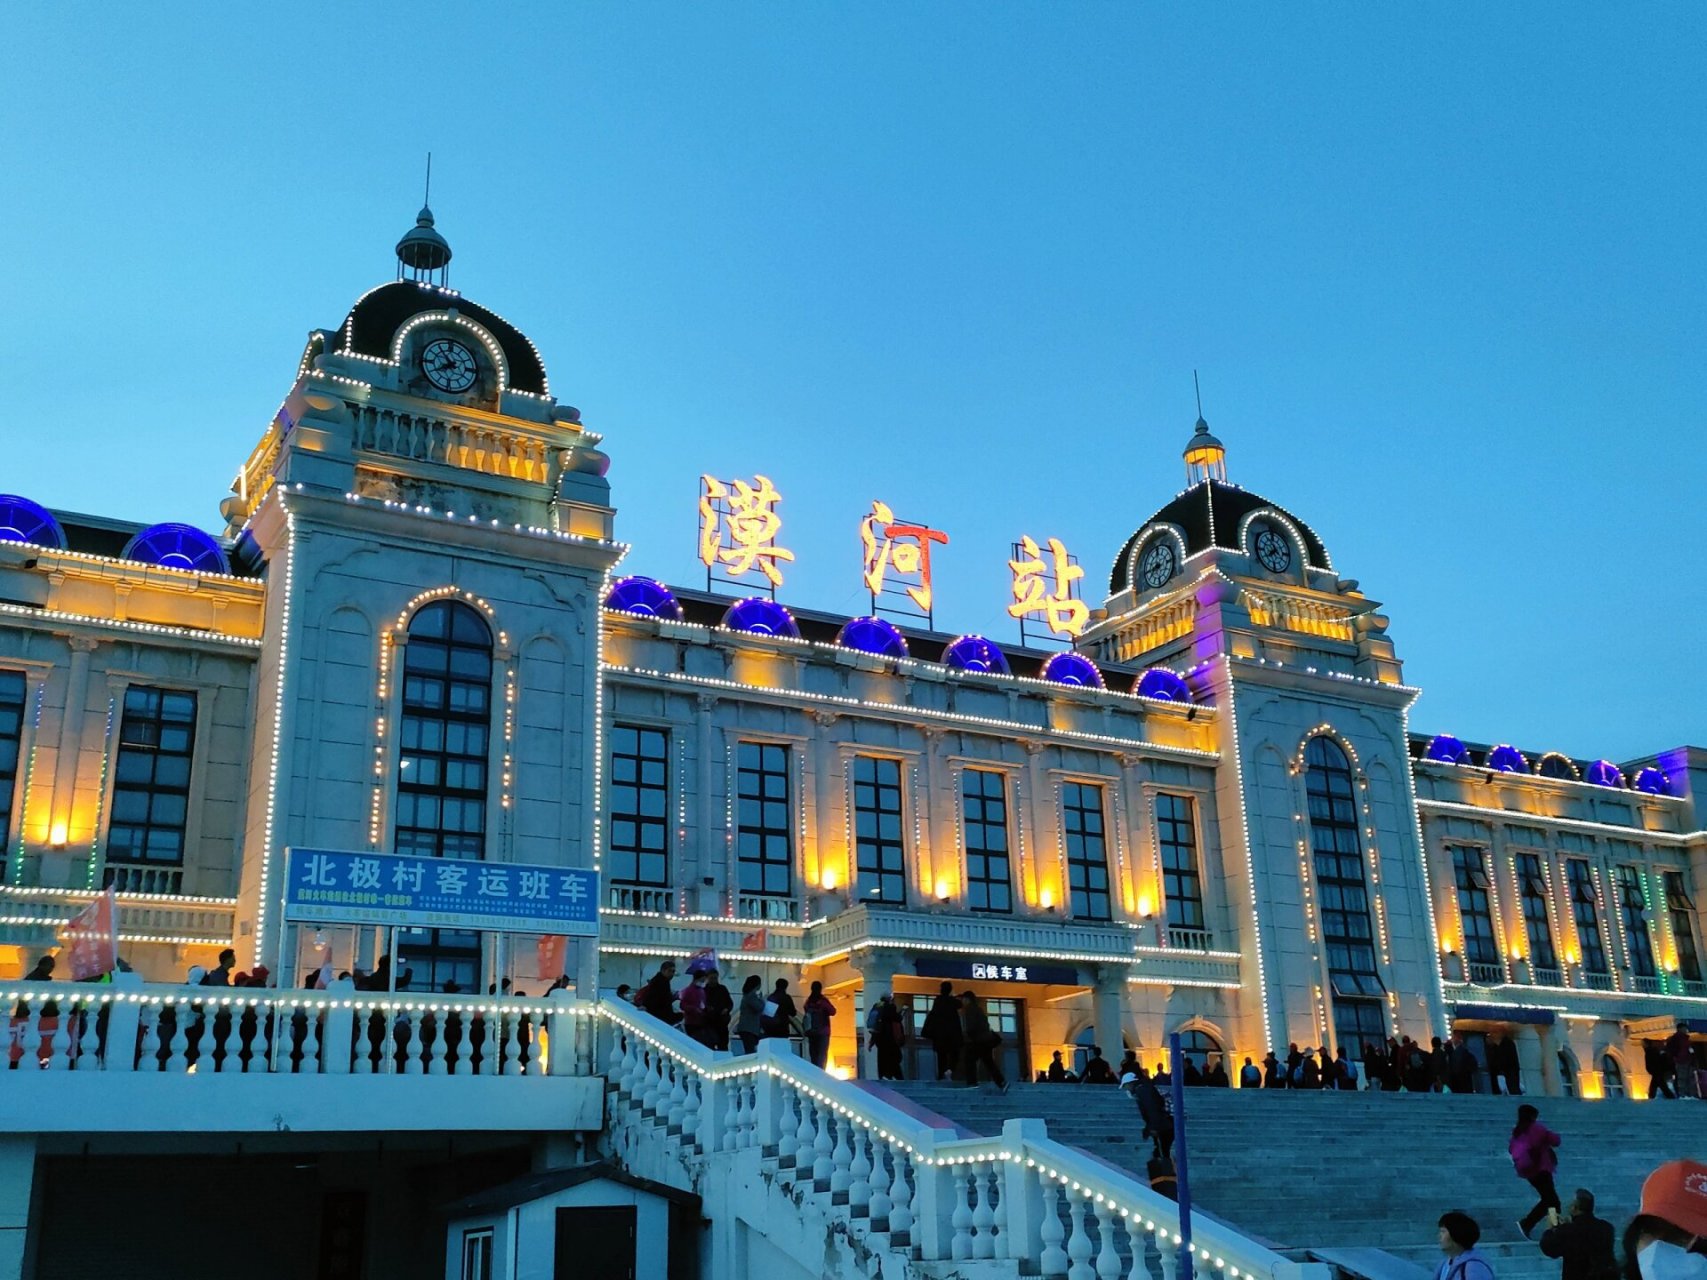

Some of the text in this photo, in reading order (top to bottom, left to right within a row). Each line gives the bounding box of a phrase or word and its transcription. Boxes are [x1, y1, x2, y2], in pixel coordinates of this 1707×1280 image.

[700, 474, 1090, 637] 漠河站
[302, 855, 588, 902] 北极村客运班车
[986, 965, 1027, 980] 候车室
